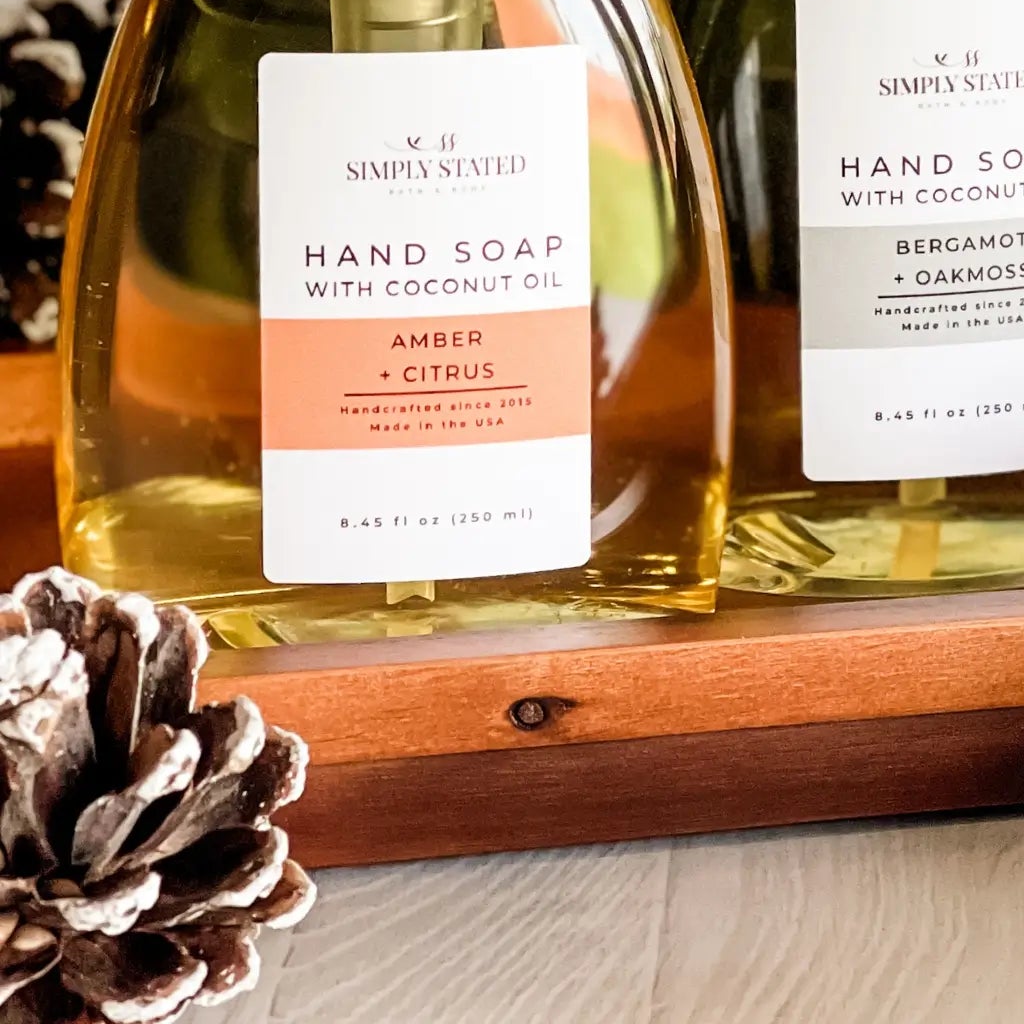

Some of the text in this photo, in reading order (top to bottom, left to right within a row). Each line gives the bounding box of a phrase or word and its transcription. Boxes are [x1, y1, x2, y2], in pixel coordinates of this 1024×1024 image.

[879, 74, 959, 96] SIMPLY
[347, 154, 526, 181] SIMPLY STATED
[841, 154, 953, 177] HAND
[841, 190, 904, 206] WITH
[306, 235, 563, 267] HAND SOAP
[306, 272, 563, 297] WITH COCONUT OIL
[875, 303, 967, 316] Handcrafted
[975, 300, 1012, 311] since
[902, 315, 1024, 331] Made in the USA
[391, 330, 483, 349] AMBER
[403, 362, 495, 383] CITRUS
[341, 397, 533, 415] Handcrafted since 2015
[875, 410, 914, 421] 8.45
[947, 409, 966, 418] oz
[976, 403, 1013, 417] (250
[370, 417, 505, 432] Made in the USA
[341, 517, 383, 528] 8.45
[419, 516, 440, 526] oz
[451, 511, 492, 526] (250
[504, 508, 534, 521] ml)
